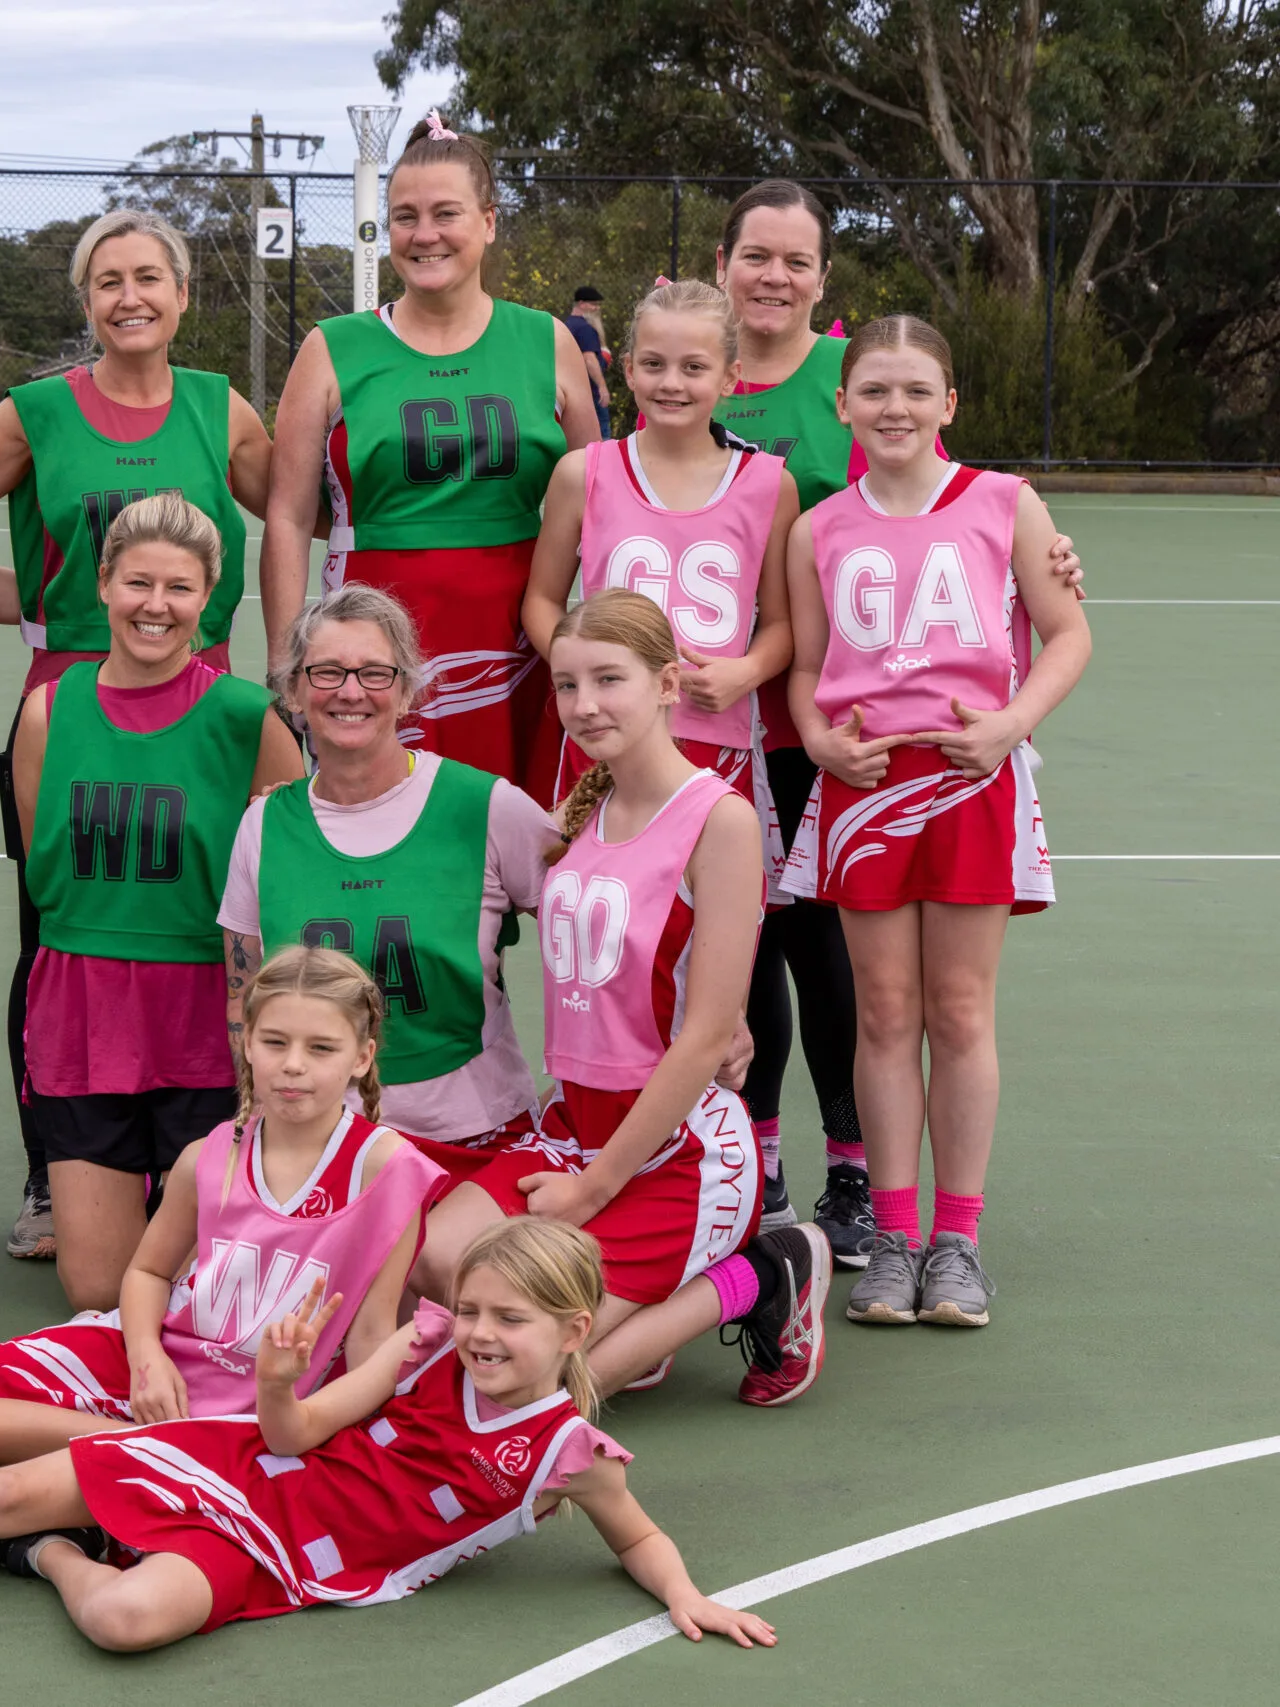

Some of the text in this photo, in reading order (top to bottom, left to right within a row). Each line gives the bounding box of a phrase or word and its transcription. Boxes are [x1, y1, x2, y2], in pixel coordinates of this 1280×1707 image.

[265, 223, 285, 254] 2
[429, 367, 470, 377] HART
[726, 409, 767, 420] HART
[400, 394, 518, 485] GD
[116, 457, 157, 467] HART
[605, 536, 741, 648] GS
[834, 542, 988, 652] GA
[69, 781, 188, 883] WD
[341, 879, 384, 890] HART
